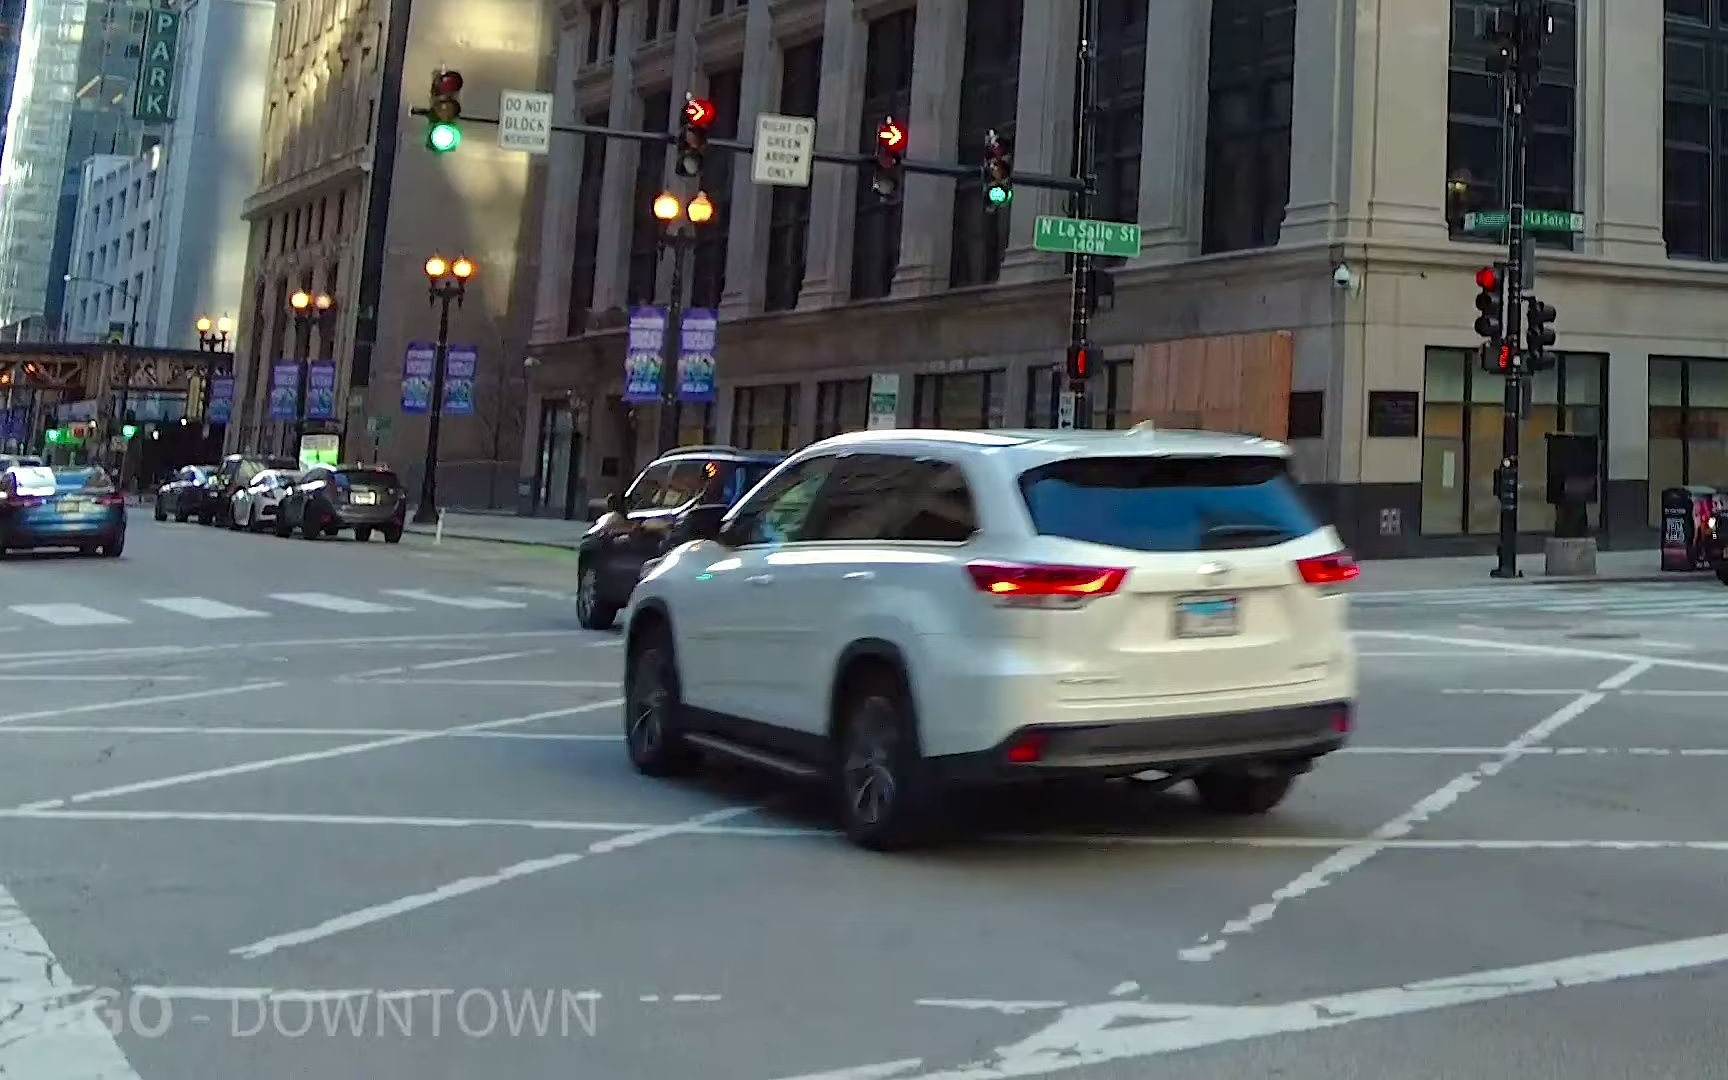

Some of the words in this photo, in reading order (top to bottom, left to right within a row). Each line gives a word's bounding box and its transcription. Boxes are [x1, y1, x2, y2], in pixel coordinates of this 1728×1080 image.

[146, 13, 173, 114] PARK
[506, 98, 521, 112] DO
[525, 100, 547, 113] NOT
[505, 116, 545, 132] BLOCK
[796, 123, 809, 135] ON
[767, 136, 801, 149] GREEN
[766, 151, 800, 163] ARROW
[767, 166, 793, 179] ONLY
[1041, 219, 1052, 235] N
[1120, 225, 1135, 242] St
